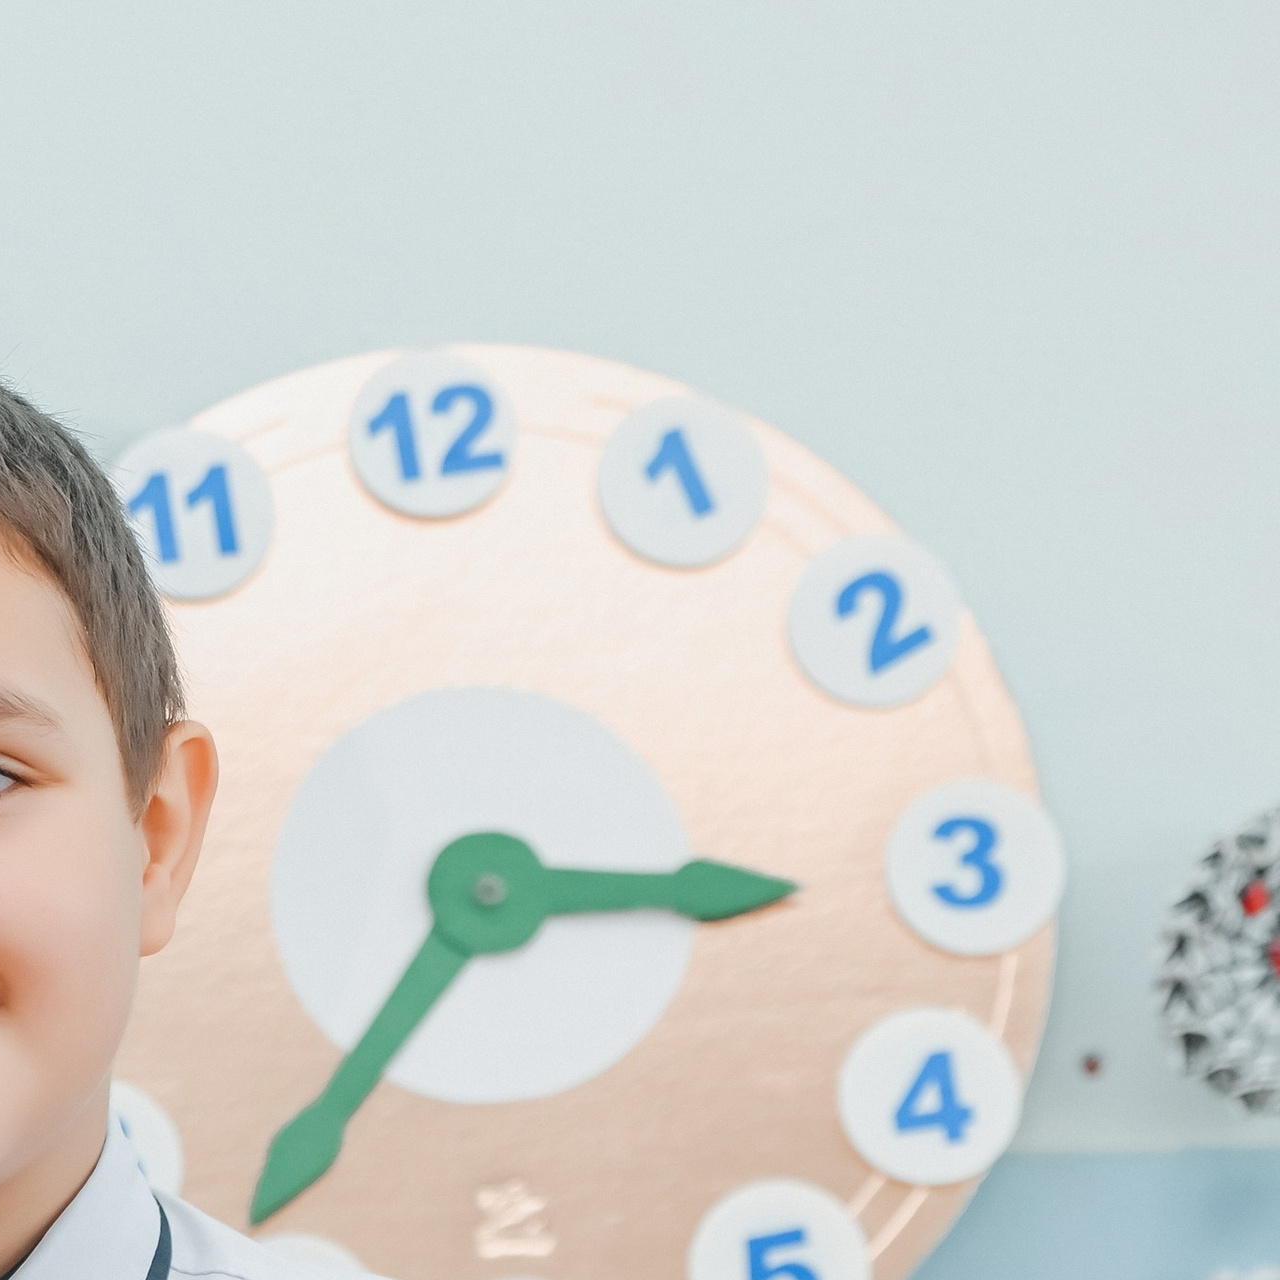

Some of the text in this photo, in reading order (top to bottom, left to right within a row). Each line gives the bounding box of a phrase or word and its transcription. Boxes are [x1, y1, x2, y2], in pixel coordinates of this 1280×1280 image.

[366, 382, 506, 483] 12
[643, 427, 716, 518] 1
[126, 462, 241, 565] 11
[834, 569, 934, 675] 2
[931, 814, 1006, 911] 3
[892, 1049, 975, 1144] 4
